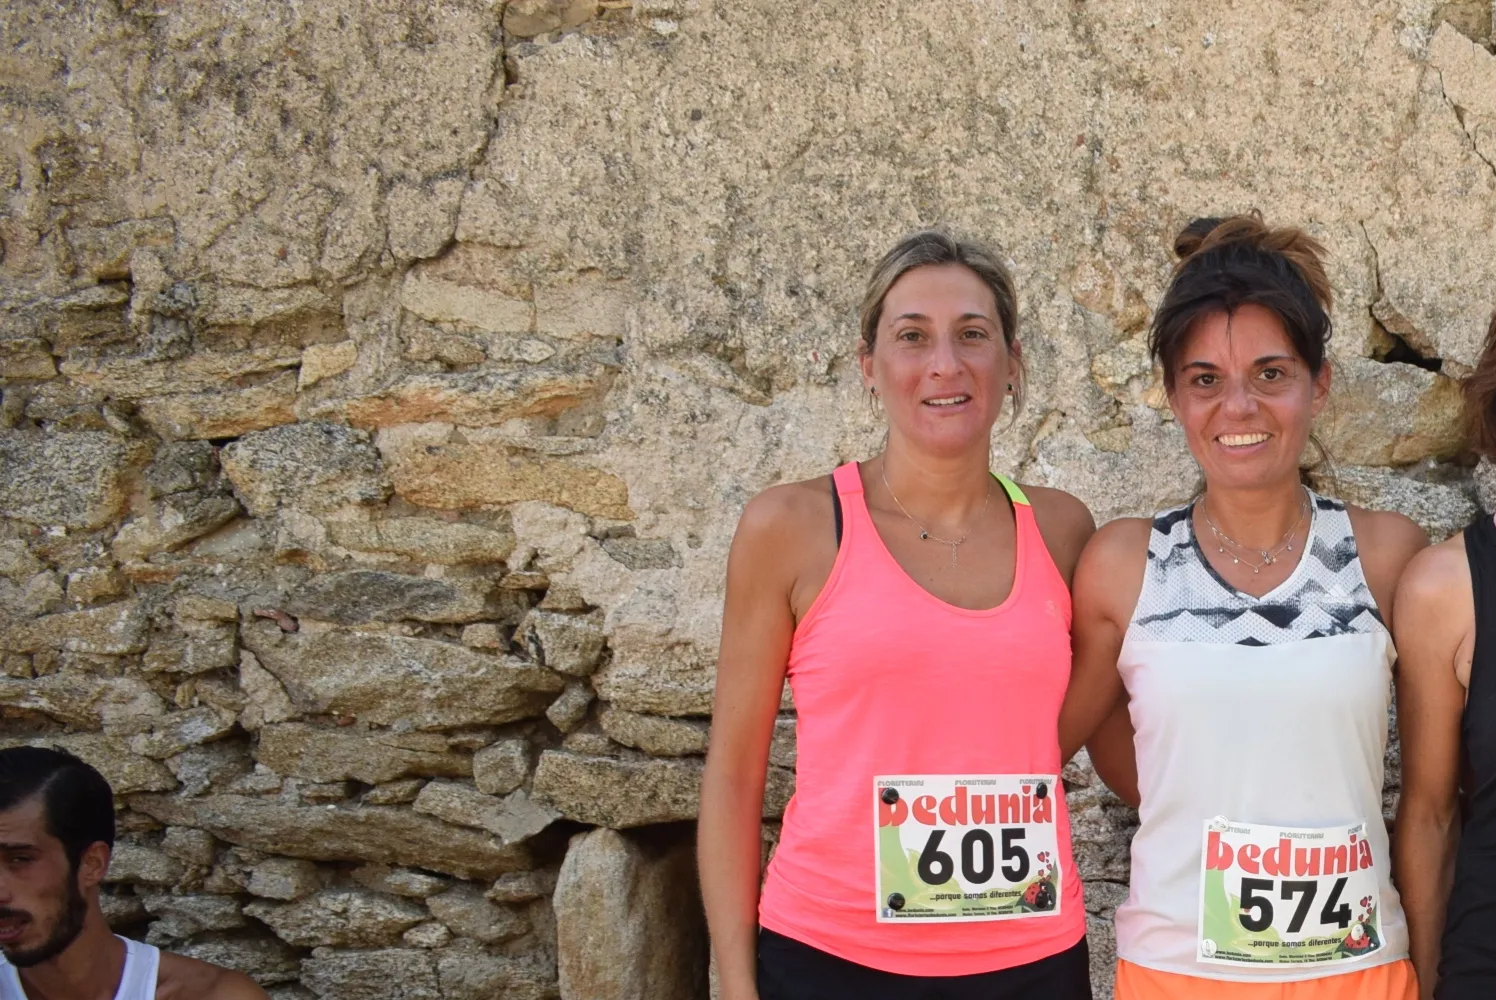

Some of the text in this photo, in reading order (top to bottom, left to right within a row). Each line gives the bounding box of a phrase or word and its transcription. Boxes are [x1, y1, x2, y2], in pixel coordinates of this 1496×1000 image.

[878, 786, 1052, 827] bedunia
[917, 828, 1030, 885] 605
[1206, 831, 1373, 877] bedunia
[964, 891, 987, 899] somos
[990, 890, 1021, 898] diferentes
[1239, 877, 1352, 933] 574
[1282, 940, 1306, 948] somos
[1308, 938, 1342, 947] diferentes
